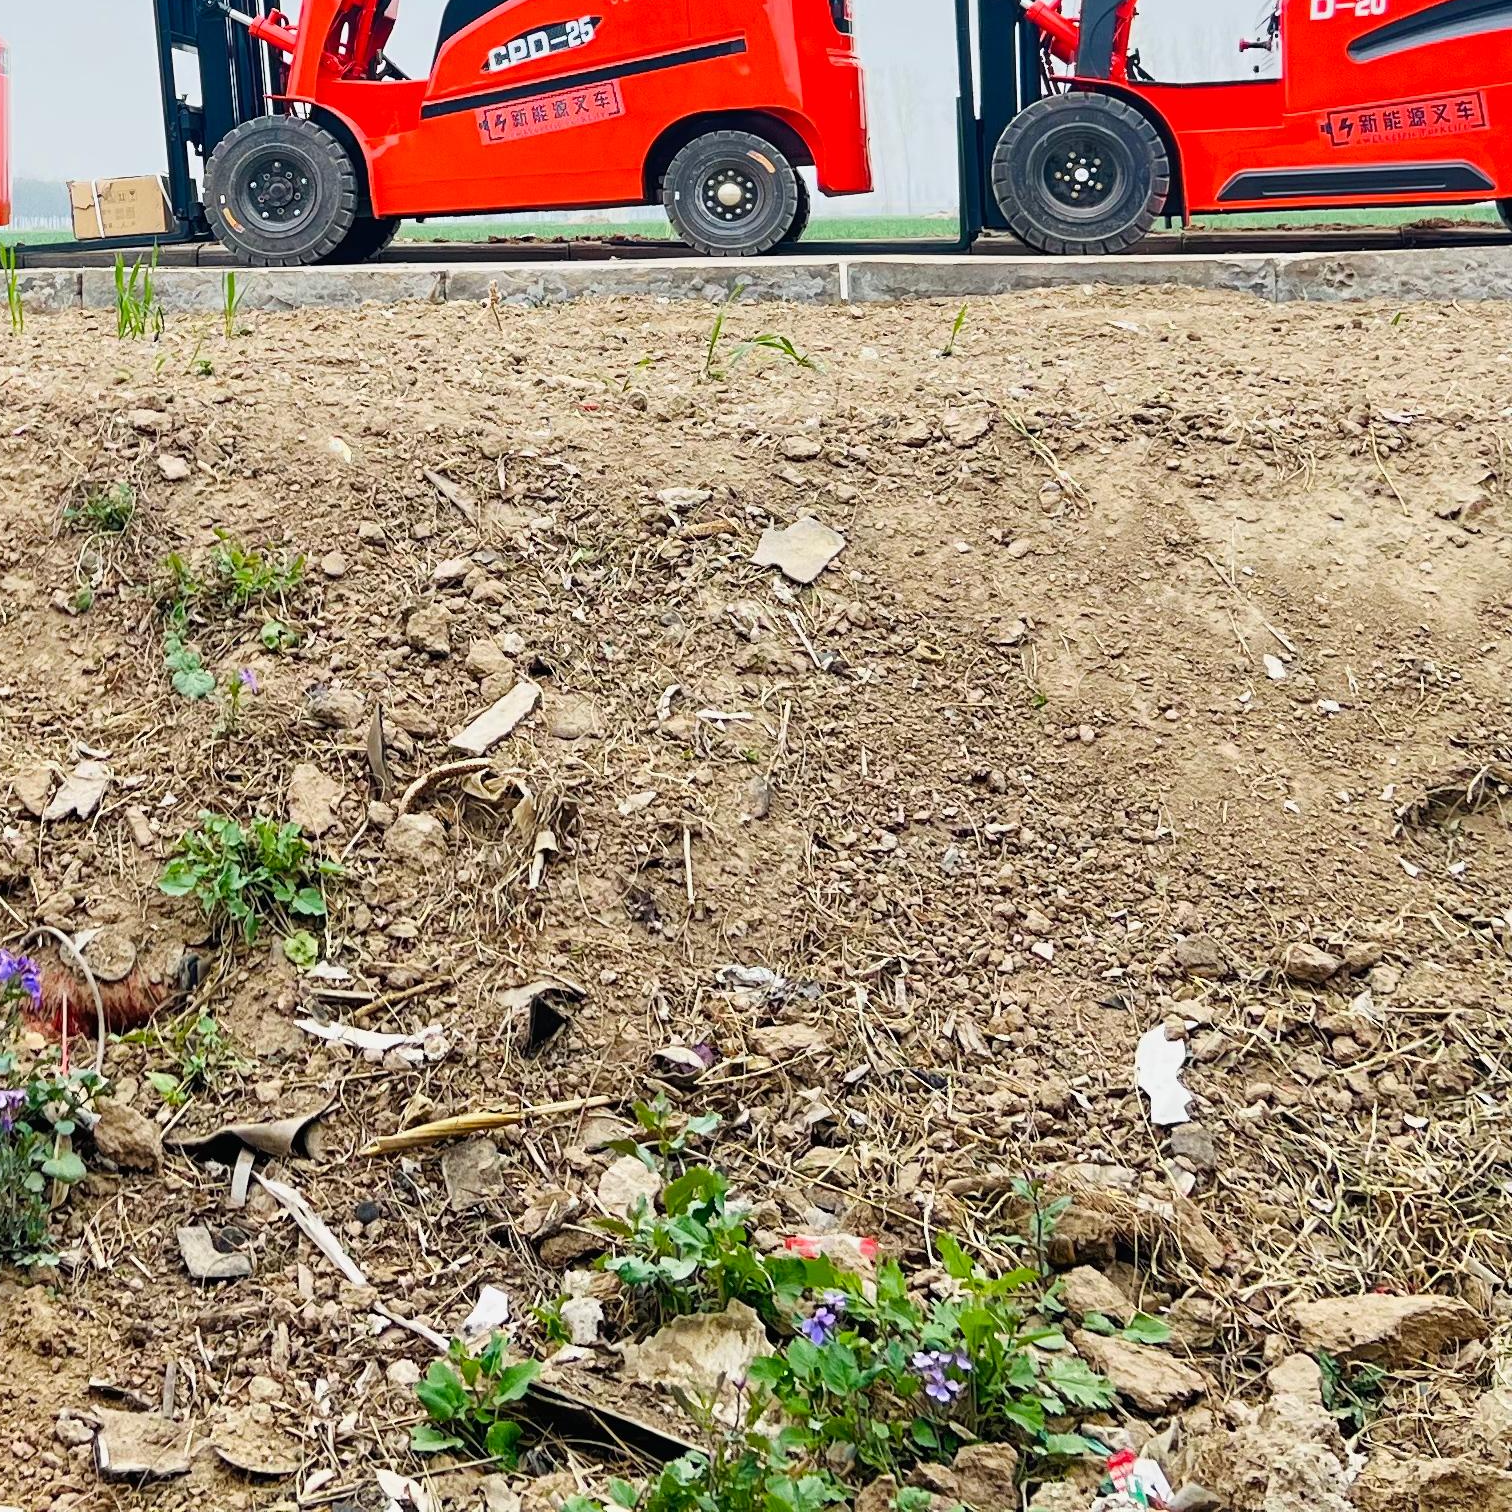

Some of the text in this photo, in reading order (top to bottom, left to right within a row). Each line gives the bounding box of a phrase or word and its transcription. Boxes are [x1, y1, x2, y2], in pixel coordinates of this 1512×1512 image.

[489, 15, 595, 72] CPD-25
[511, 91, 610, 127] 新能源叉车
[1359, 100, 1475, 134] 新能源叉车
